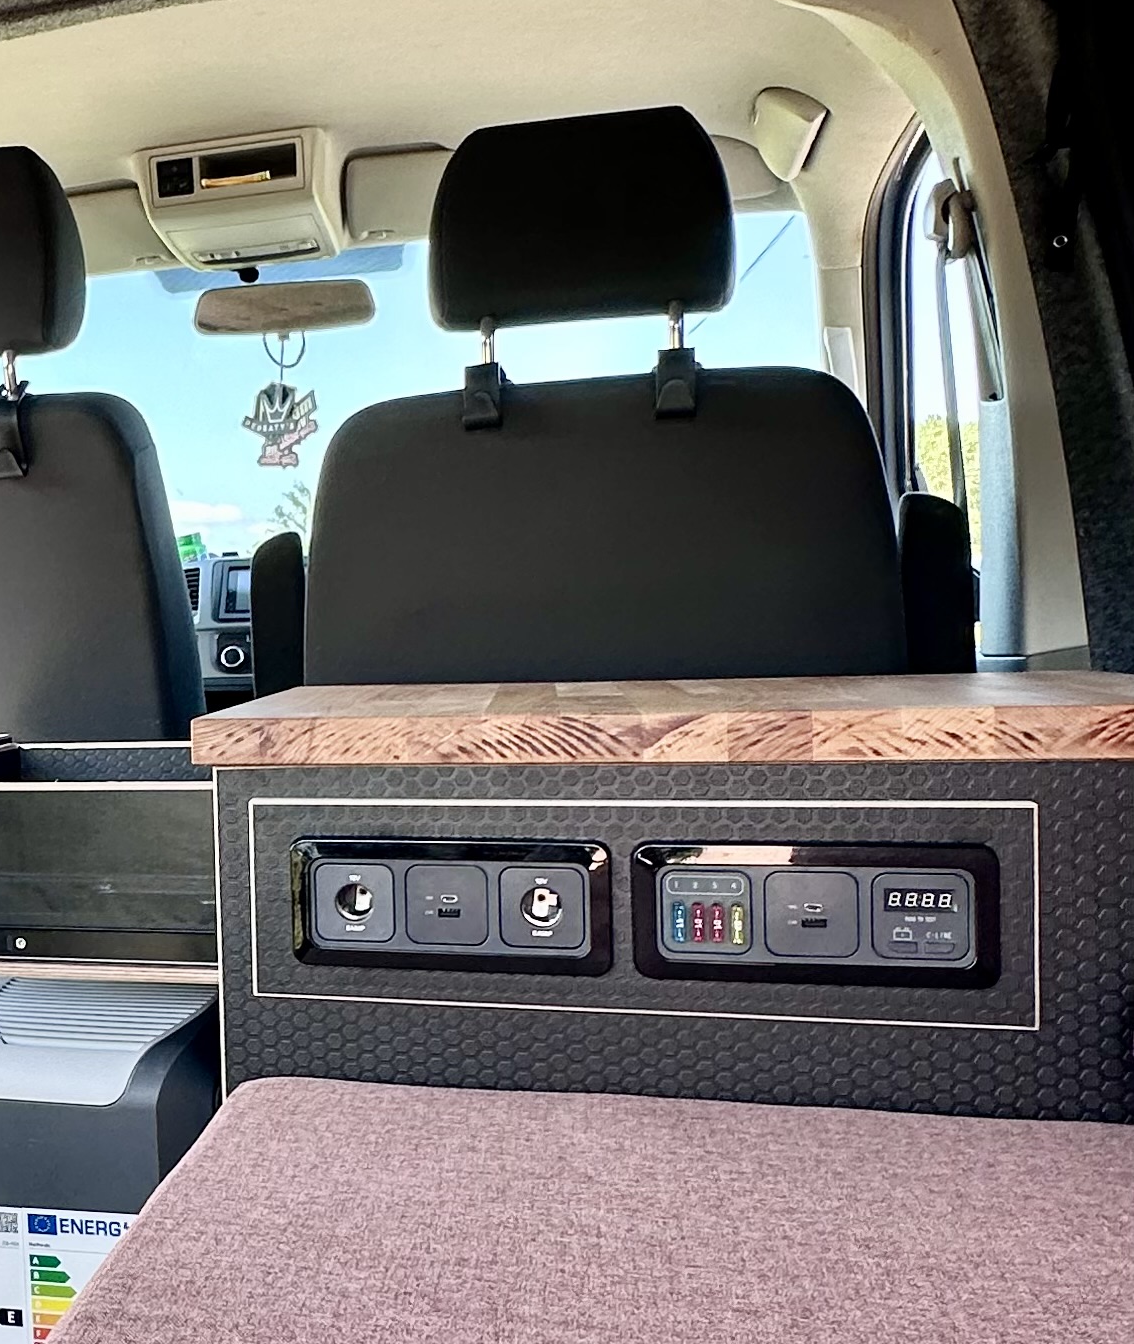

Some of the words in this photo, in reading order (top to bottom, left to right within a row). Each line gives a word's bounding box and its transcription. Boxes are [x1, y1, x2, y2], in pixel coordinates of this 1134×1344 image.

[59, 1217, 122, 1237] ENERG
[32, 1257, 40, 1266] A
[6, 1310, 16, 1324] E
